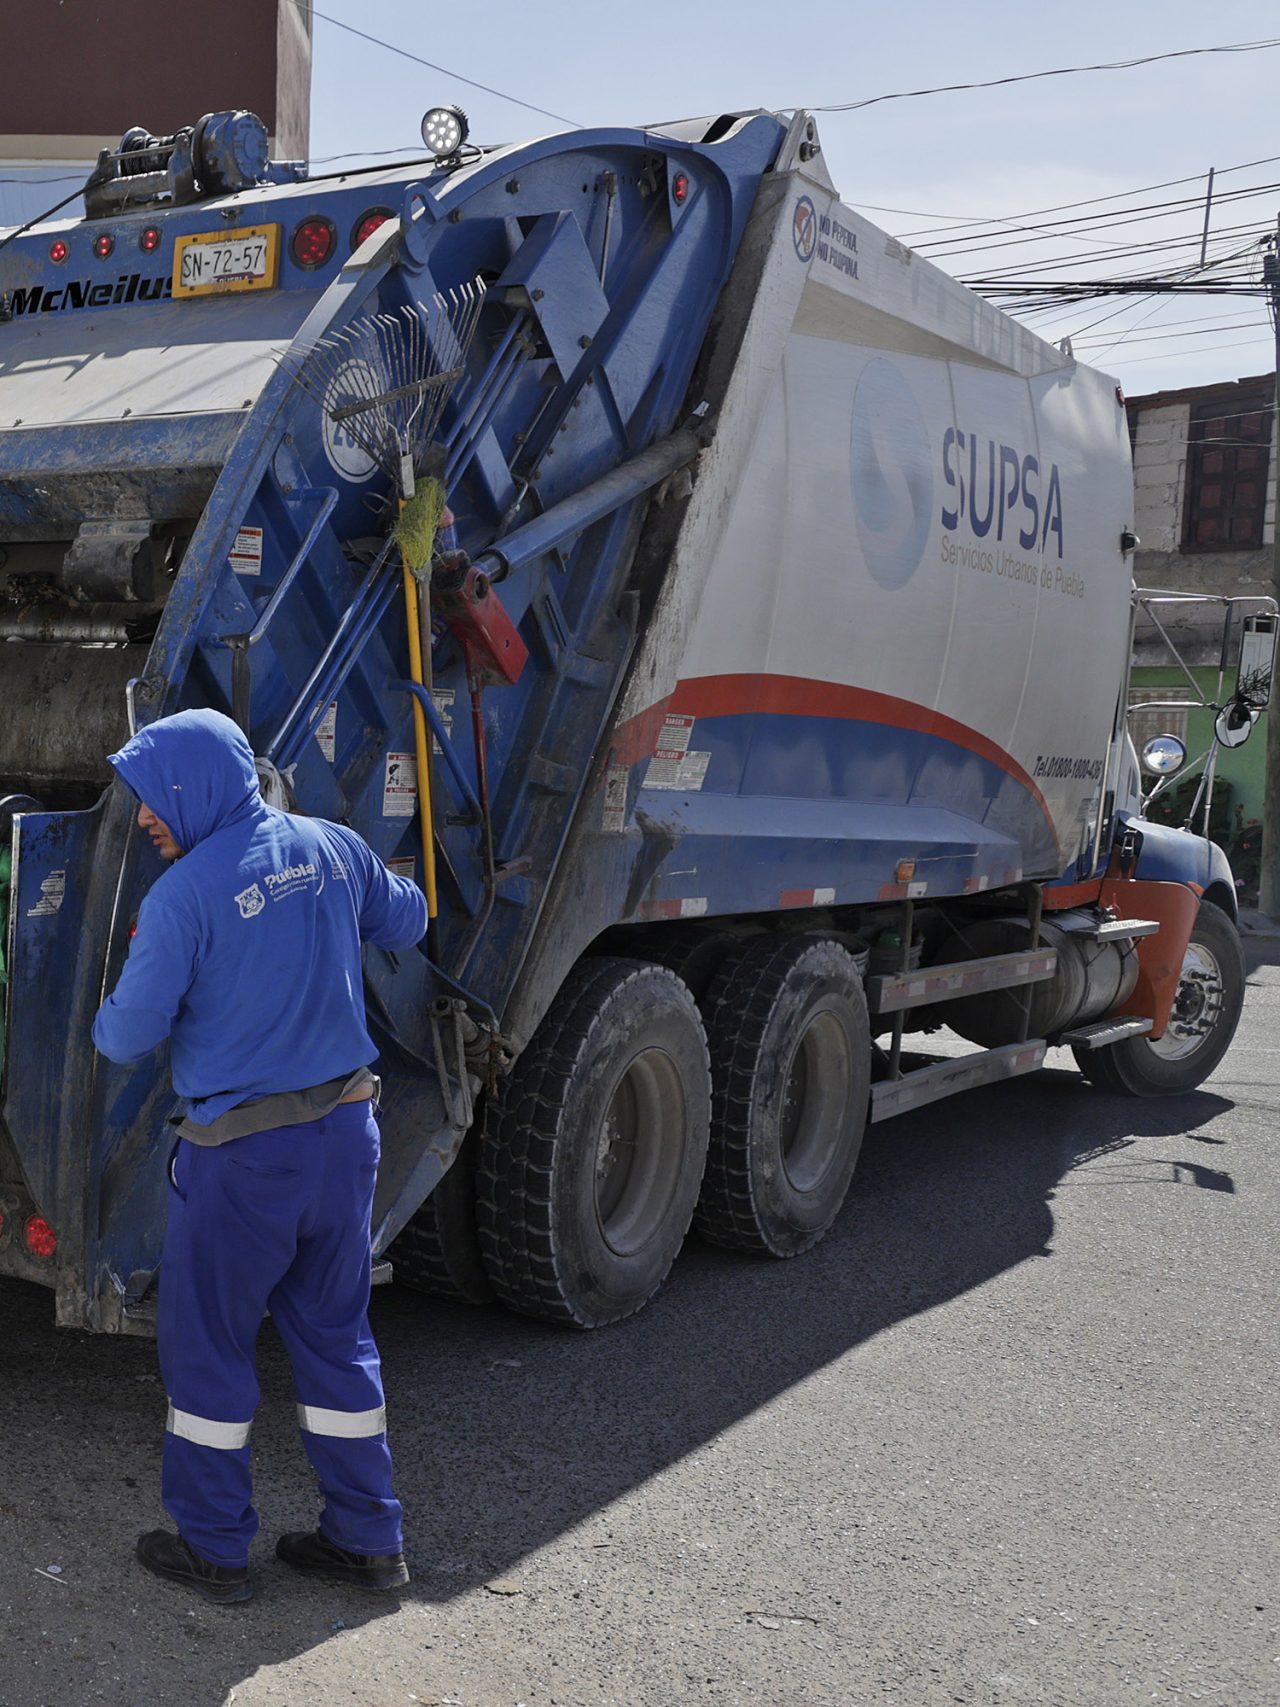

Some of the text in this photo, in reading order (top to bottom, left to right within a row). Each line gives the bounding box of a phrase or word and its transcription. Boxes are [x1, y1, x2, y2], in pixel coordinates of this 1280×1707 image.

[818, 214, 830, 236] NO
[817, 240, 829, 262] NO
[941, 427, 1063, 559] SUPSA
[941, 534, 1085, 599] Servicios Urbanos de Puebla
[264, 863, 317, 889] Puebla
